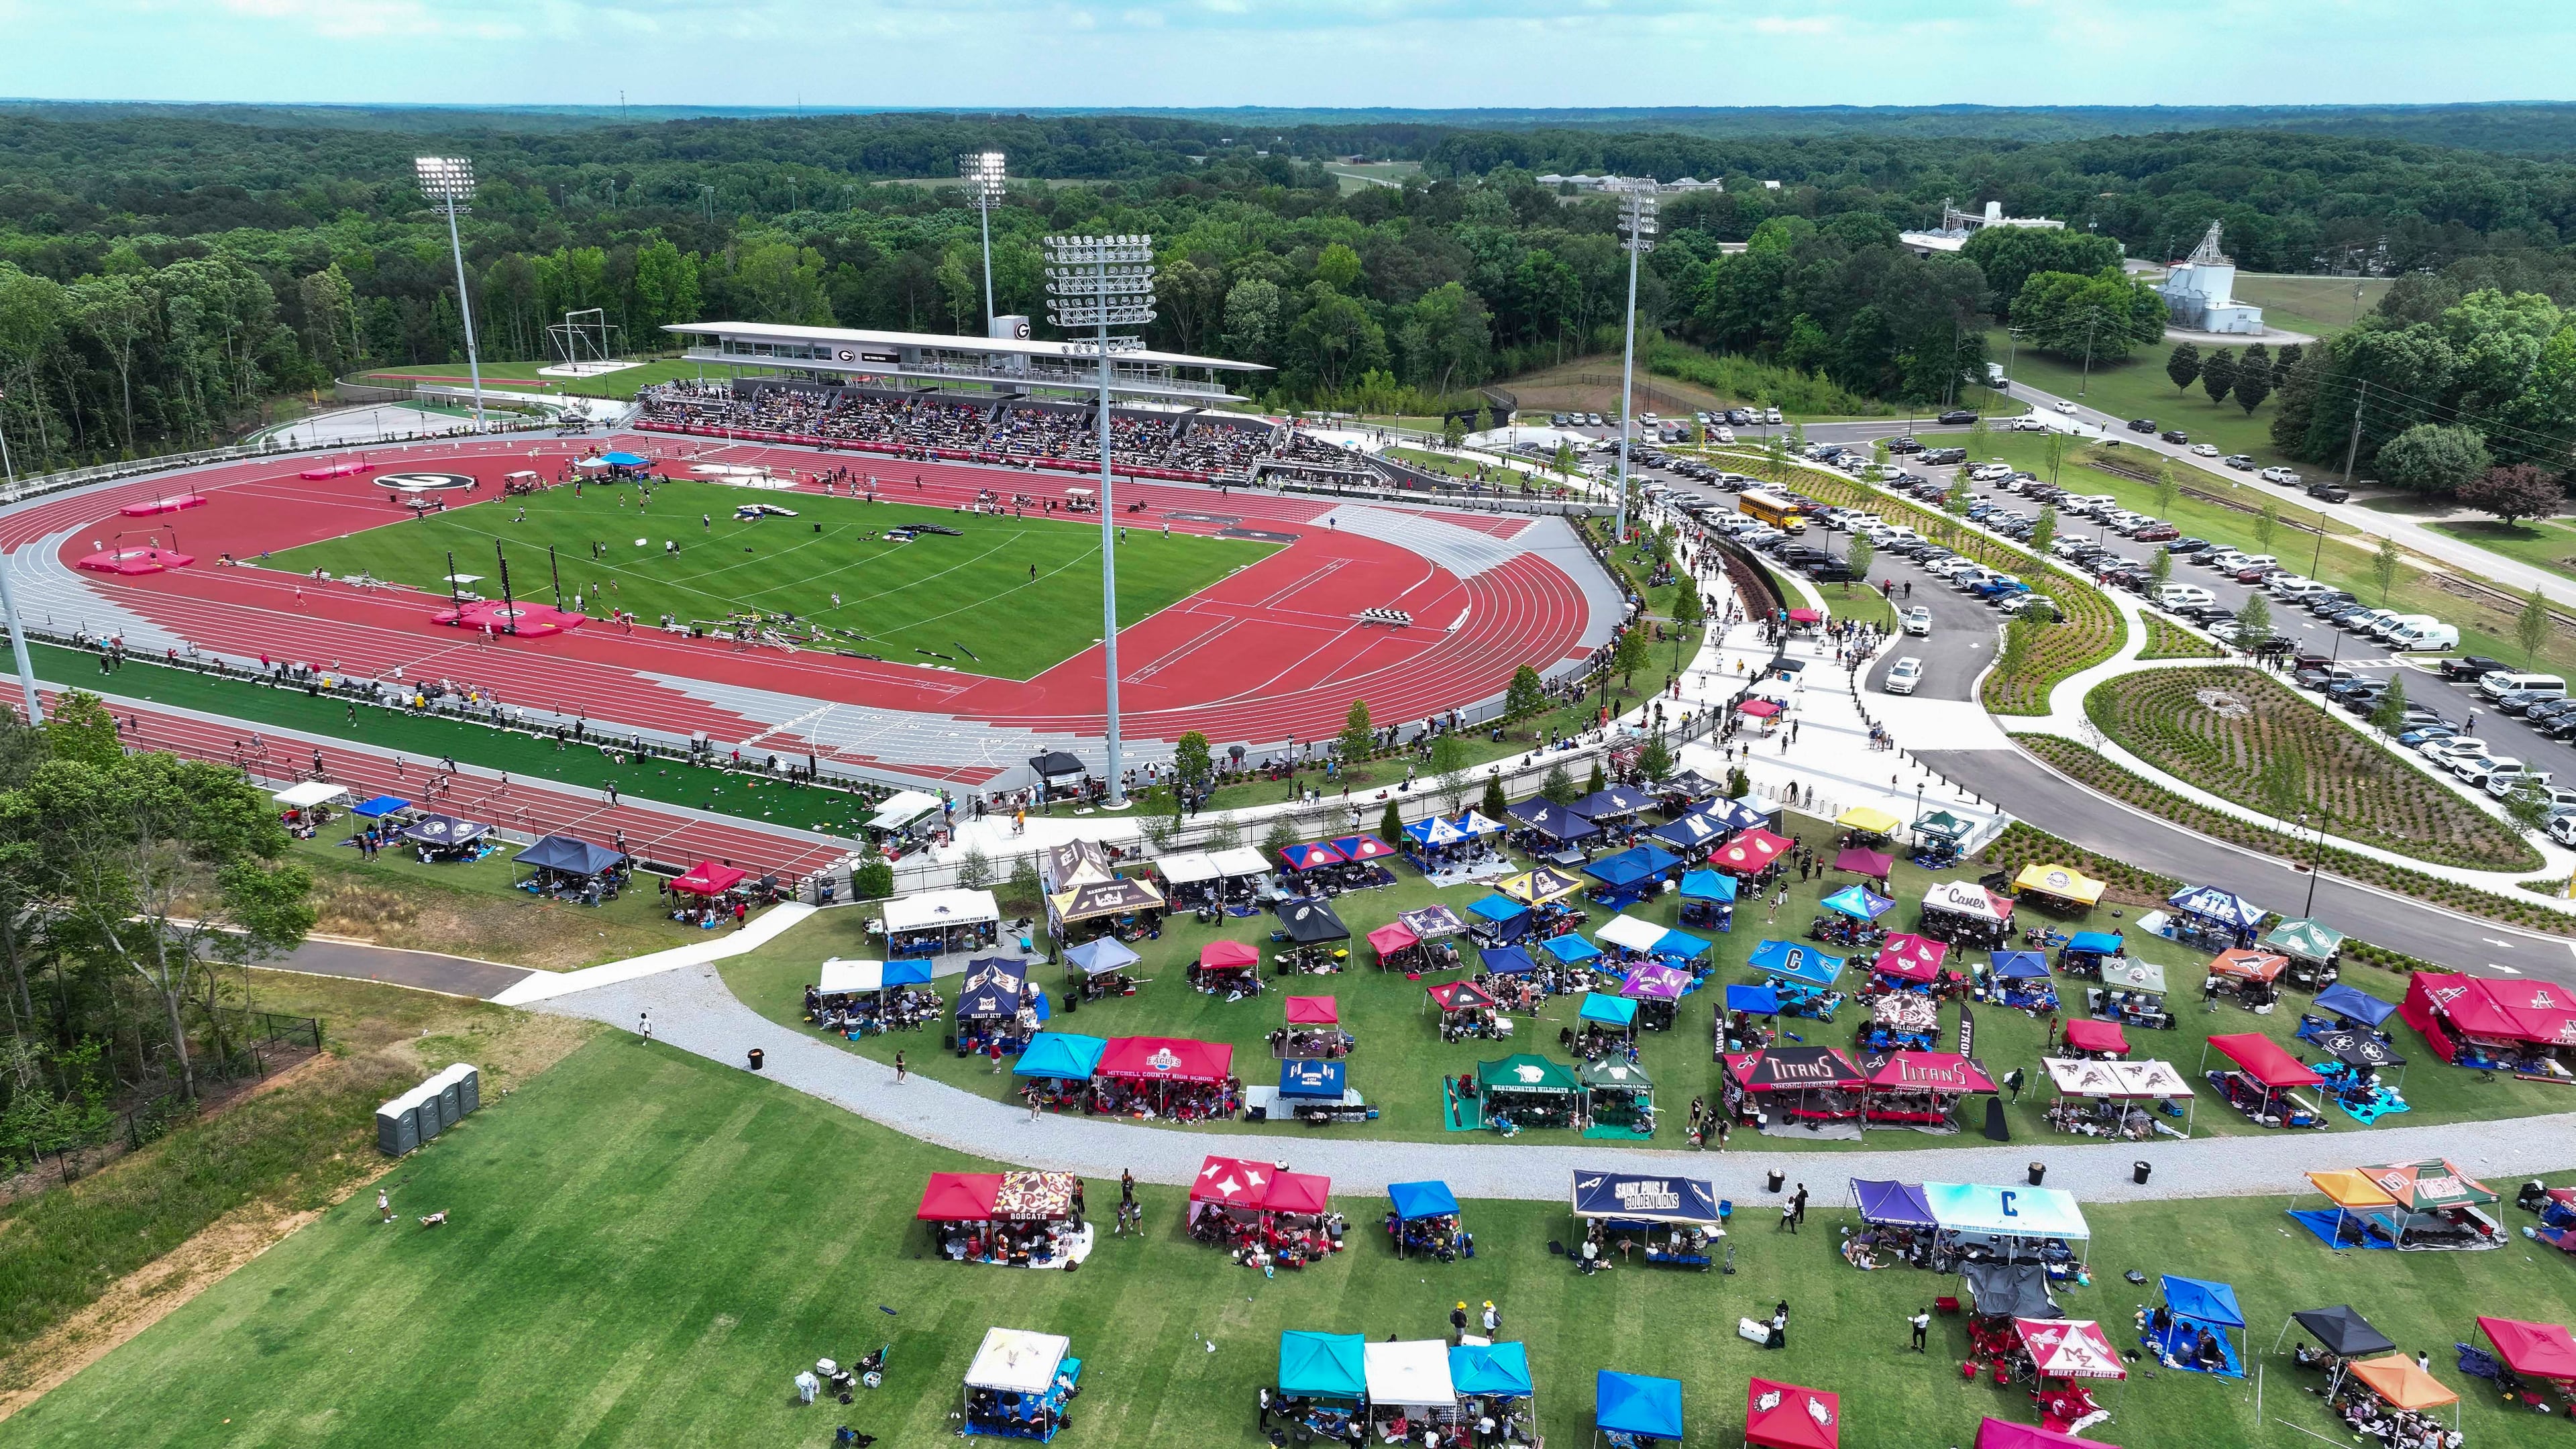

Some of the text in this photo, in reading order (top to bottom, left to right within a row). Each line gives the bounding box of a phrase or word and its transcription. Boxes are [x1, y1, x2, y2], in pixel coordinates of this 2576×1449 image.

[1015, 323, 1030, 339] G
[838, 350, 855, 362] G
[1610, 808, 1635, 818] ACADEMY
[1635, 802, 1658, 812] KNIGHTS
[1707, 797, 1737, 820] N
[1507, 809, 1559, 841] PACE ACADEMY KNIGHTS
[1685, 813, 1713, 837] N
[1948, 888, 1986, 910] Canes
[1422, 930, 1450, 940] GREENVILLE
[1785, 948, 1804, 971] C
[2530, 990, 2556, 1009] A
[1715, 1018, 1725, 1054] NORTH
[1890, 1024, 1924, 1033] BULLDOGS
[1960, 1020, 1971, 1058] NORTH
[1146, 1054, 1181, 1068] EAGLES
[1766, 1055, 1834, 1081] TITANS
[1896, 1058, 1966, 1085] TITANS
[1492, 1084, 1537, 1093] WESTMINSTER
[1894, 1083, 1931, 1092] NORTH
[1615, 1181, 1669, 1199] SAINT PIUS X
[2414, 1175, 2468, 1199] TIGERS
[1625, 1193, 1679, 1209] GOLDEN LIONS
[2001, 1191, 2018, 1218] C
[1950, 1224, 1980, 1232] ATLANTA
[1981, 1226, 2019, 1234] CLASSICAL
[2093, 1371, 2120, 1379] EAGLES
